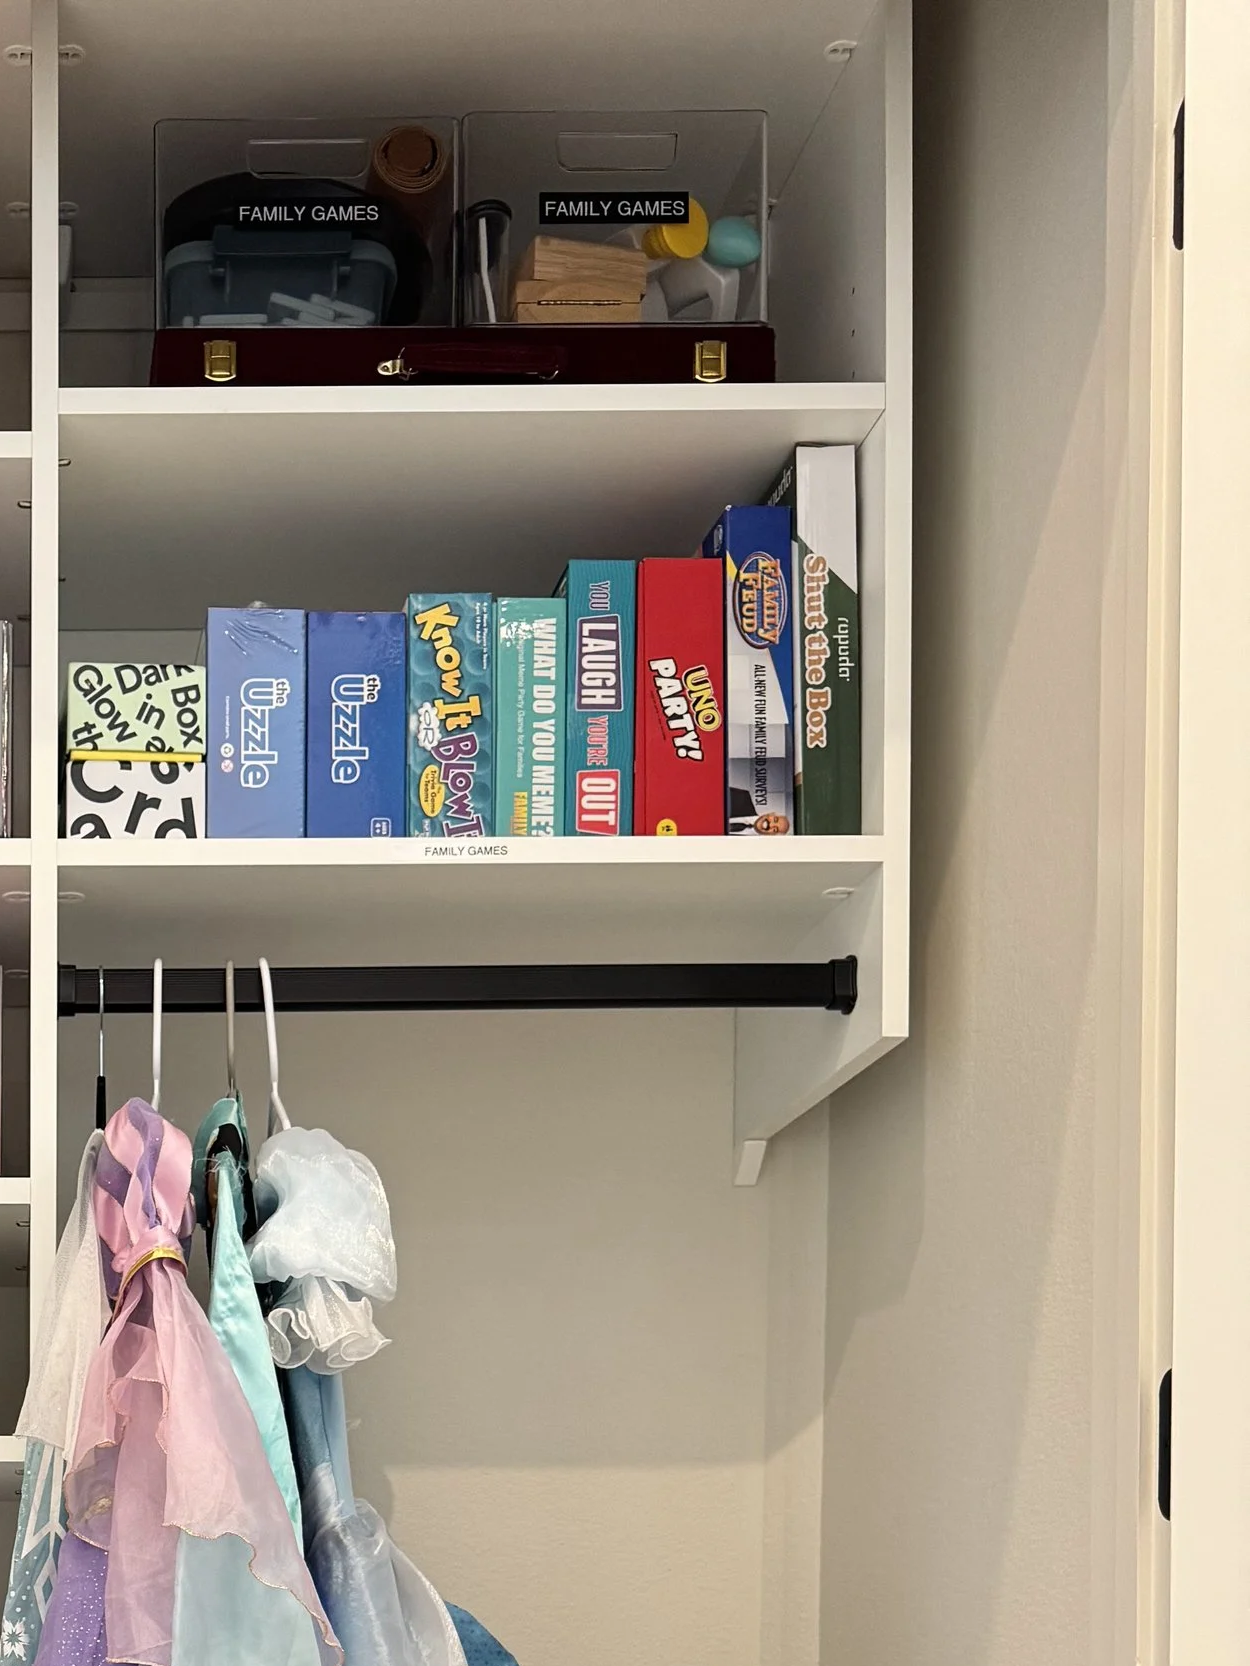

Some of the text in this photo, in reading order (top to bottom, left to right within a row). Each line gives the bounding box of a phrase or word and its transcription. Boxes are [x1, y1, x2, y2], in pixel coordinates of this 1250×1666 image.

[240, 206, 378, 221] FAMILY GAMES
[546, 201, 684, 216] FAMILY GAMES
[589, 580, 610, 611] YOU
[739, 571, 762, 634] FEUD
[758, 558, 781, 645] FAMILY
[414, 603, 482, 732] Know It
[581, 622, 617, 705] LAUGH
[804, 554, 831, 749] Shut the Box
[73, 664, 138, 743] Glow
[135, 693, 166, 731] in
[171, 684, 203, 748] Box
[275, 680, 289, 705] the
[366, 676, 379, 701] the
[516, 663, 526, 778] Meme Party Game for Families
[648, 657, 704, 762] PARTY!
[682, 665, 722, 732] UNO
[240, 678, 278, 788] Uzzle
[331, 674, 369, 784] Uzzle
[422, 710, 436, 745] OR
[531, 617, 557, 837] WHAT DO YOU MEME?
[587, 715, 609, 766] YOU'RE
[754, 664, 768, 806] ALL-NEW FUN FAMILY FEUD SURVEYS!
[513, 791, 528, 836] FAMILY
[581, 777, 616, 826] OUT
[425, 846, 508, 856] FAMILY GAMES
